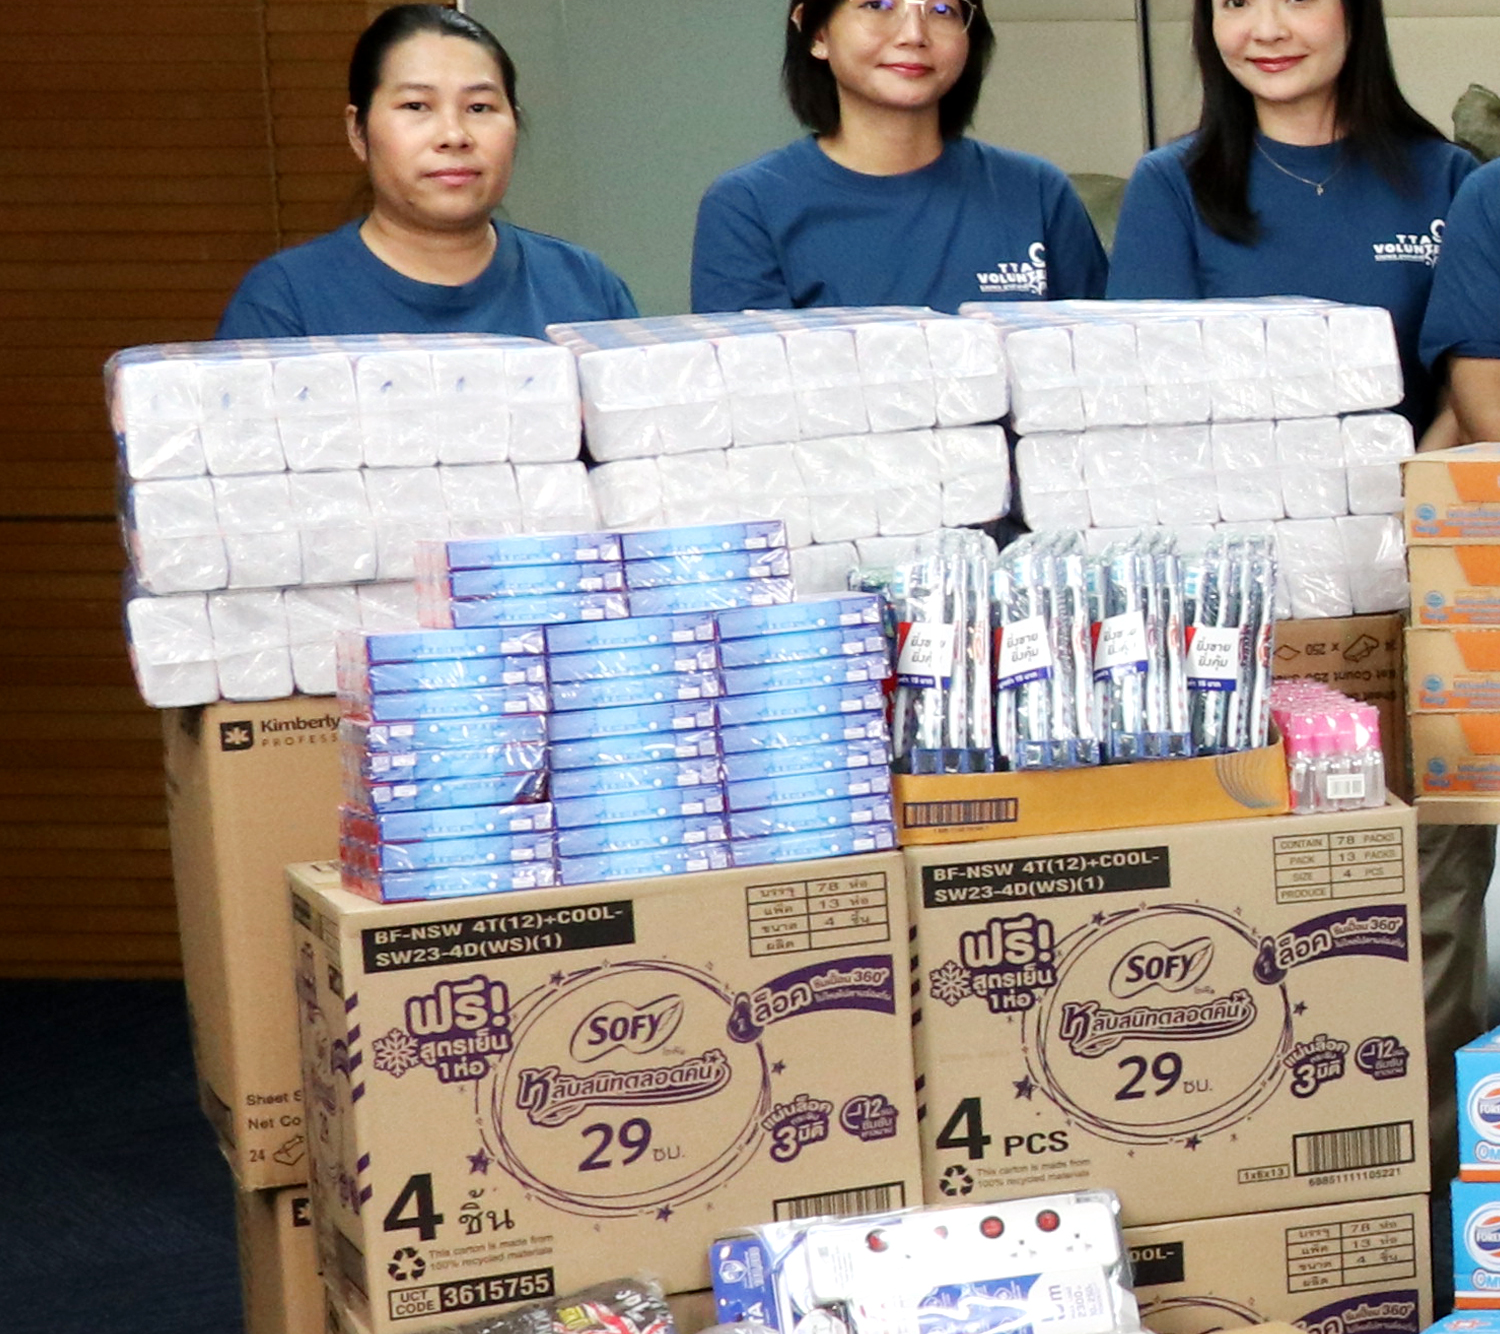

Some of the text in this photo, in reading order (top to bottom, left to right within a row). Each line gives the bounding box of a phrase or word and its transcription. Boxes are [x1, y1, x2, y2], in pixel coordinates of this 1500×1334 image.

[1396, 234, 1431, 245] TTA
[998, 263, 1032, 274] TTA
[261, 713, 340, 733] Kimberly
[933, 851, 1160, 882] BF-NSW 4T(12)+COOL-
[934, 875, 1105, 903] SW23-4D(WS)(1)
[374, 906, 623, 945] BF-NSW 4T(12)+COOL-
[375, 933, 563, 968] SW23-4D(WS)(1)
[963, 917, 1054, 968] ฟรี!
[972, 965, 1054, 997] สูตรเย็น
[1126, 954, 1193, 984] SOFY
[408, 976, 508, 1036] ฟรี!
[1062, 993, 1250, 1049] หลับสนิทตลอดคืน
[588, 1013, 663, 1046] SOFY
[419, 1027, 510, 1066] สูตรเย็น
[518, 1053, 726, 1113] หลับสนิทตลอดคืน
[1114, 1051, 1183, 1102] 29
[246, 1093, 288, 1106] Sheet
[248, 1118, 274, 1130] Net
[935, 1096, 1070, 1161] 4 PCS
[578, 1117, 652, 1172] 29
[382, 1172, 515, 1243] 4 ชิ้น
[395, 1299, 437, 1316] CODE
[398, 1289, 428, 1303] UCT
[443, 1275, 551, 1308] 3615755
